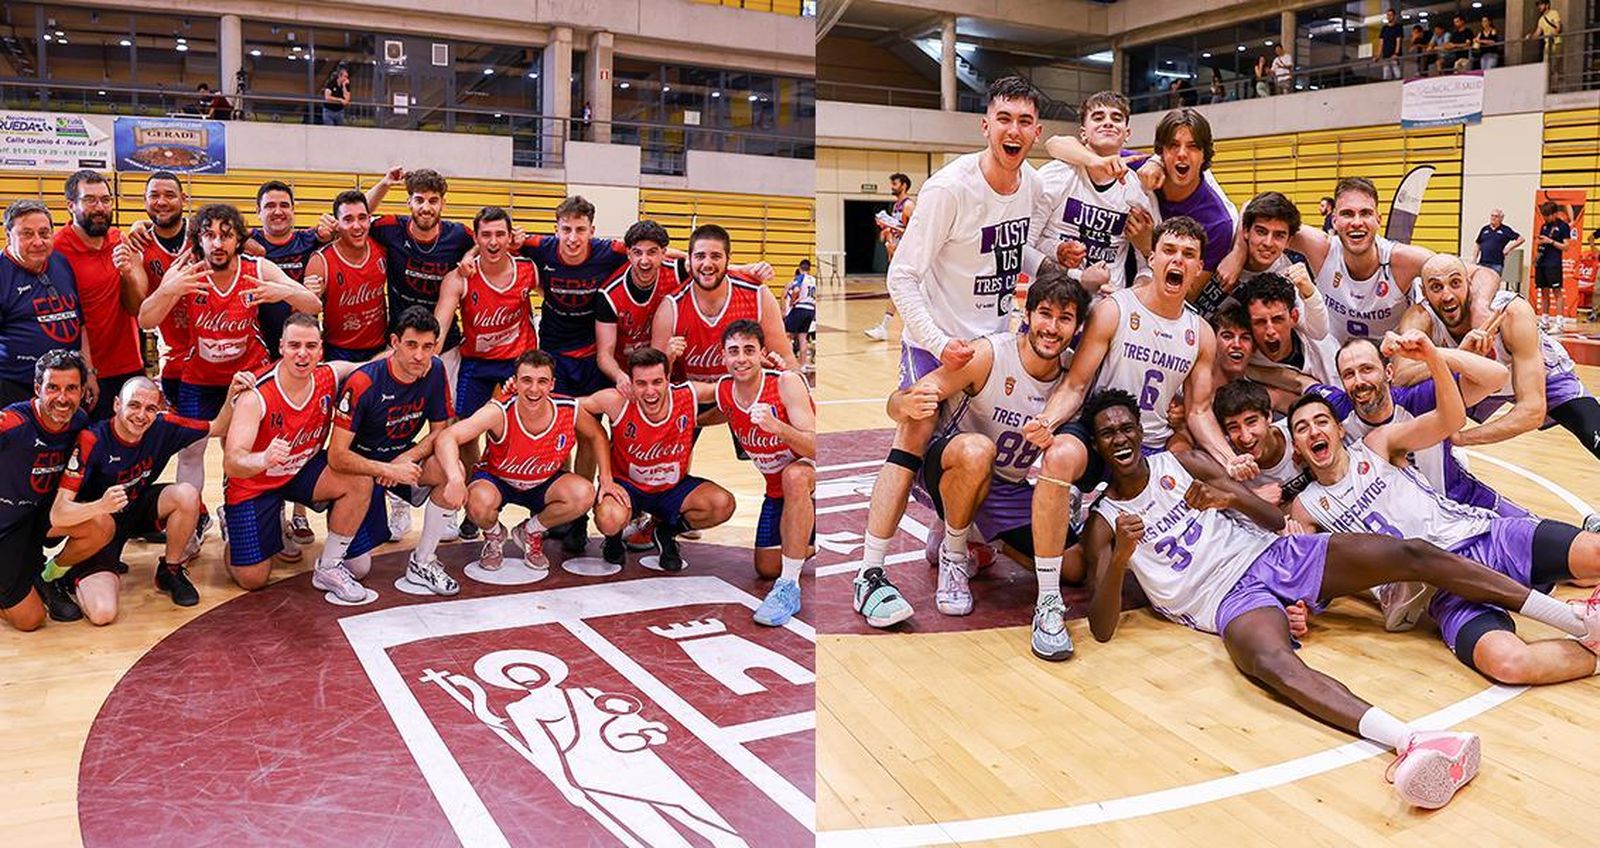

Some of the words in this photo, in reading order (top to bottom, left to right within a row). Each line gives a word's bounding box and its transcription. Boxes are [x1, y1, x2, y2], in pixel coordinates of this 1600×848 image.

[1073, 203, 1120, 233] JUST
[991, 219, 1028, 249] JUST
[1002, 249, 1018, 271] US
[976, 278, 1002, 293] TRES
[1324, 293, 1347, 316] TRES
[1348, 307, 1392, 320] CANTOS
[1123, 342, 1151, 362] TRES
[1151, 350, 1192, 374] CANTOS
[1139, 369, 1165, 411] 6
[270, 412, 283, 429] 14
[992, 406, 1022, 428] TRES
[994, 430, 1042, 468] 88
[1350, 477, 1387, 518] CANTOS
